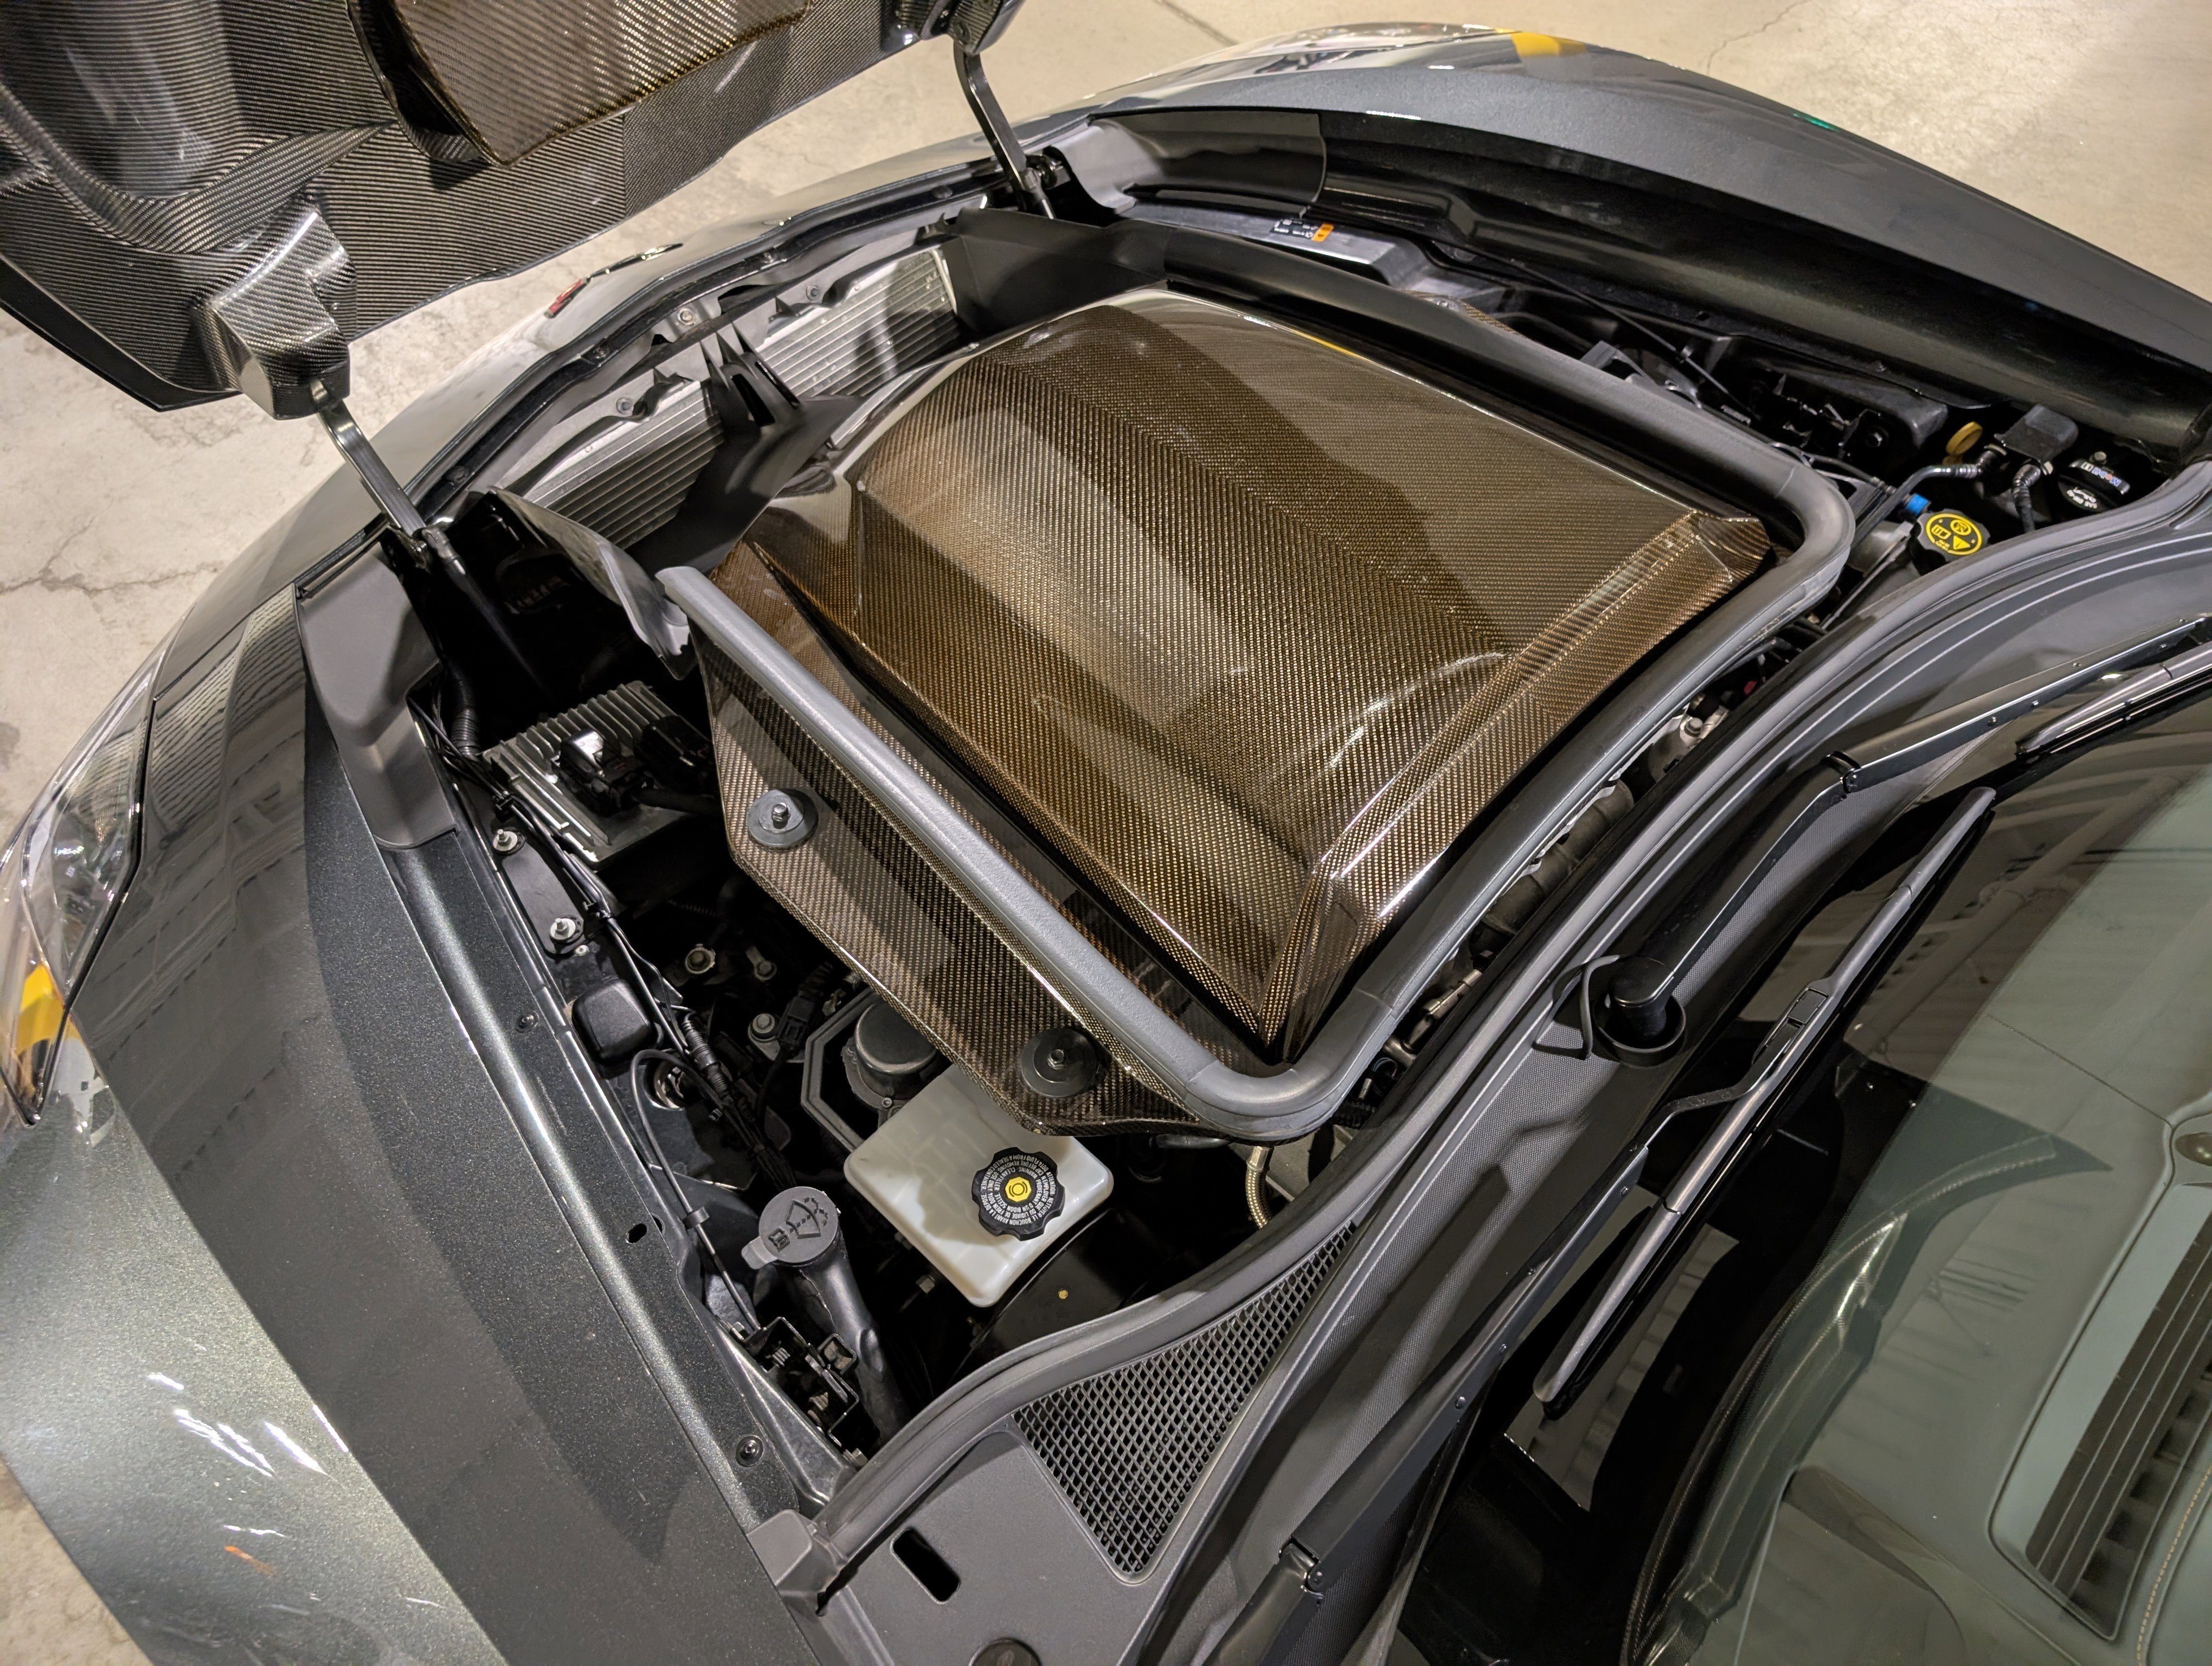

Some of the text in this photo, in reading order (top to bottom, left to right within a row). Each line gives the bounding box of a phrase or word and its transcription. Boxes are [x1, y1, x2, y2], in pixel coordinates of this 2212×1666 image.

[993, 1156, 1009, 1169] SEALED
[1026, 1155, 1039, 1164] FLUID
[1020, 1160, 1037, 1170] BEFORE
[990, 1171, 999, 1181] USE
[1001, 1167, 1015, 1177] CLEAN
[1035, 1168, 1044, 1176] CAP
[994, 1175, 1004, 1190] FILLER
[1032, 1178, 1043, 1204] PROVENANT
[992, 1203, 1005, 1215] FREIN
[1035, 1201, 1044, 1211] QUE
[1037, 1197, 1054, 1218] NETTOYER
[994, 1214, 1009, 1224] AVANT
[1009, 1217, 1032, 1226] BOUCHON
